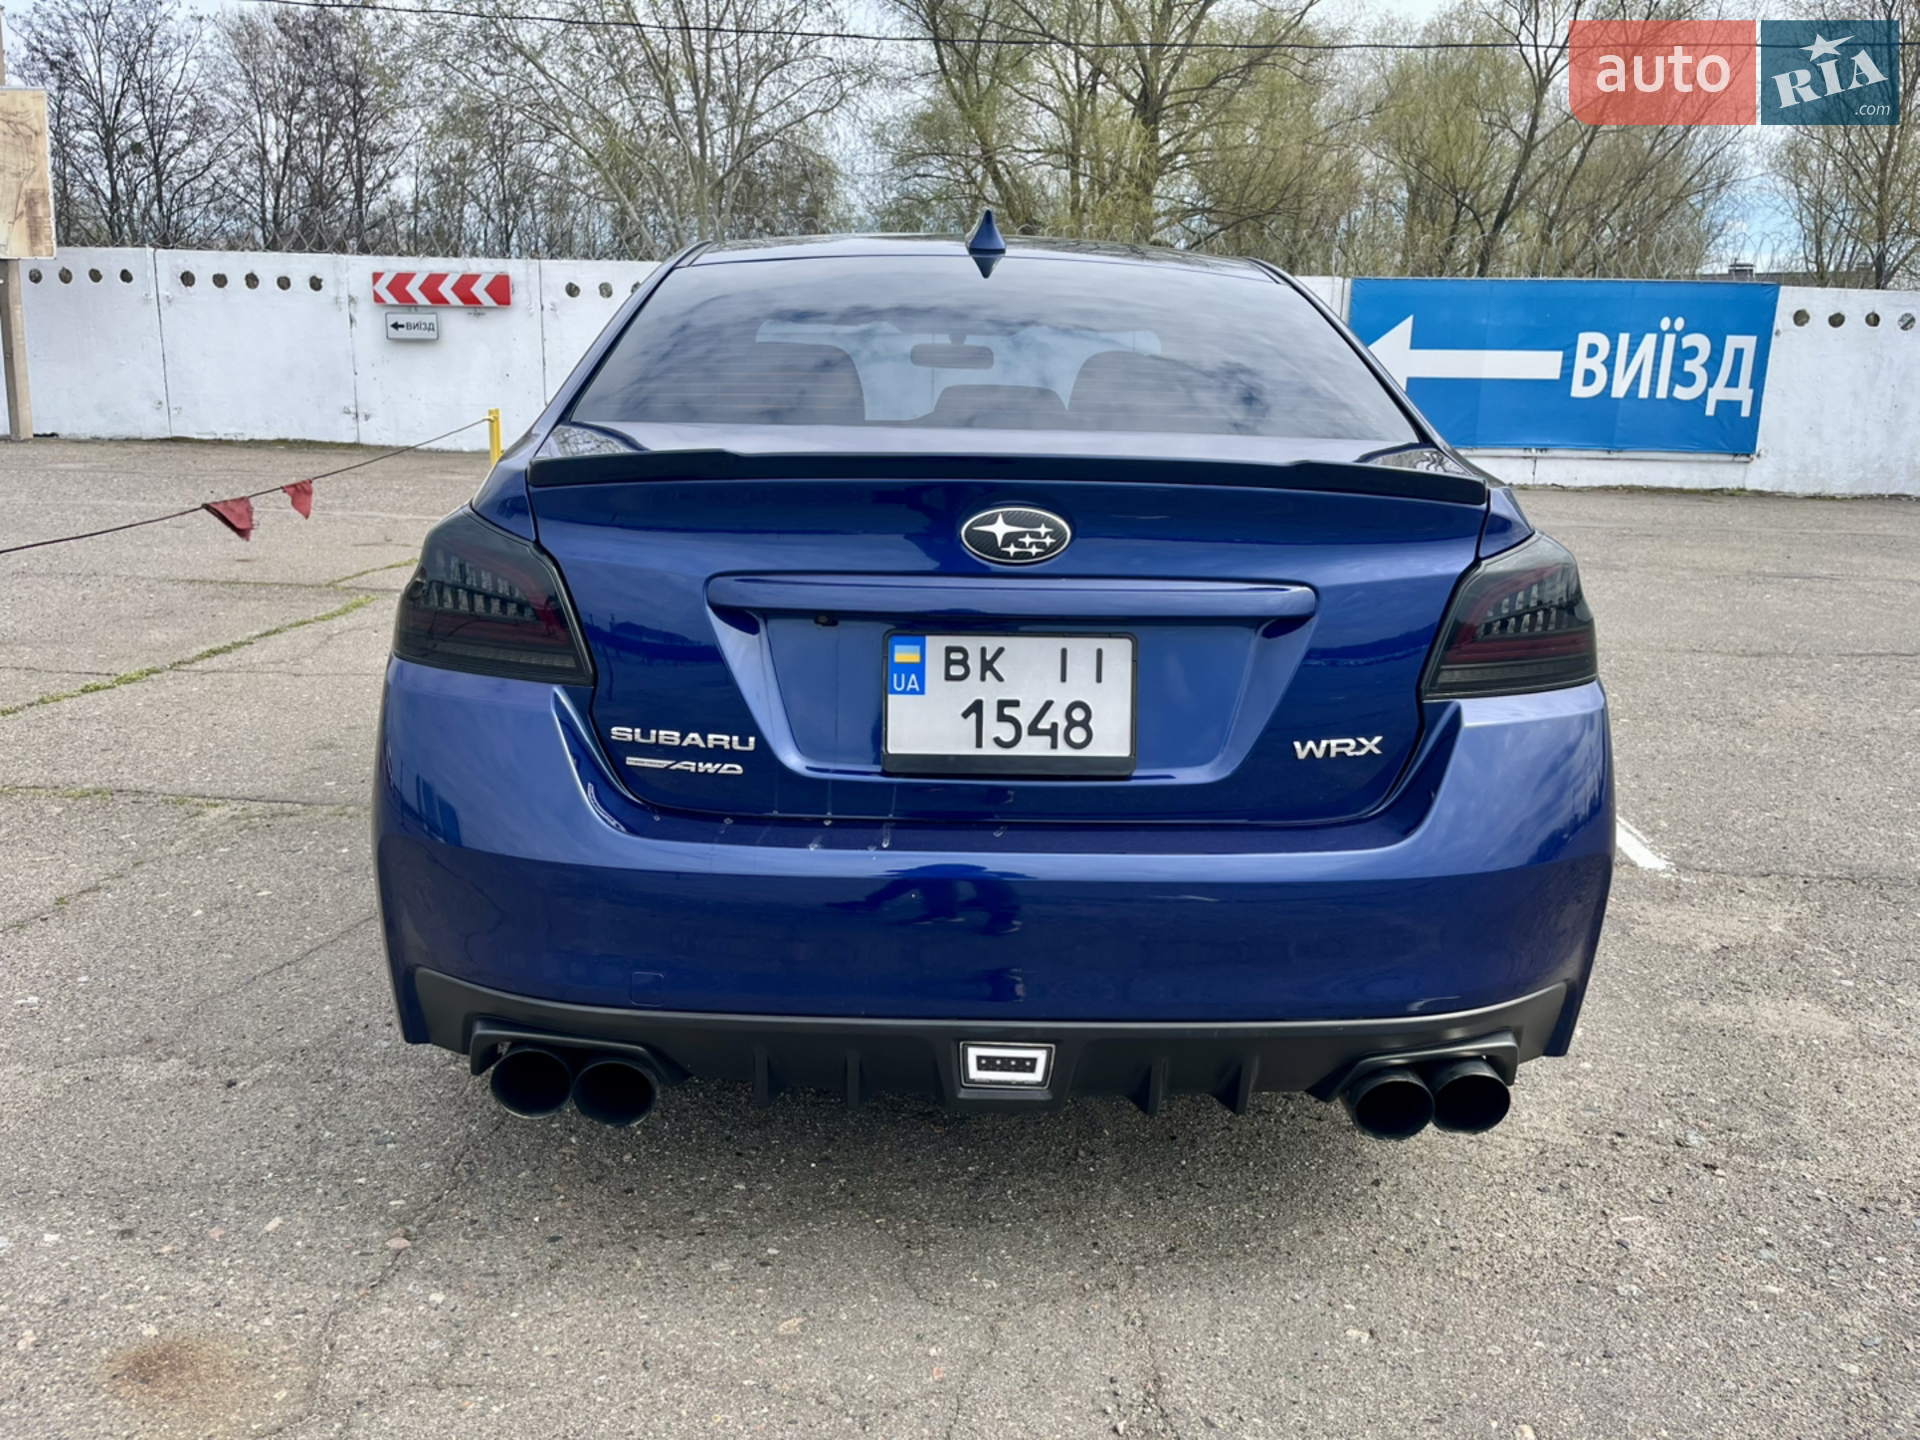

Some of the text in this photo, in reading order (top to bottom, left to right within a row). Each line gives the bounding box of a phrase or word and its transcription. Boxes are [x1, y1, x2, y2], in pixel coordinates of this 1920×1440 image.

[405, 321, 436, 333] ВИЇЗД
[1570, 316, 1758, 418] ВИЇЗД
[944, 645, 1006, 682] BK
[893, 673, 920, 692] UA
[961, 698, 1093, 750] 1548
[610, 726, 756, 751] SUBARU
[1293, 735, 1383, 760] WRX
[669, 760, 744, 775] AWD
